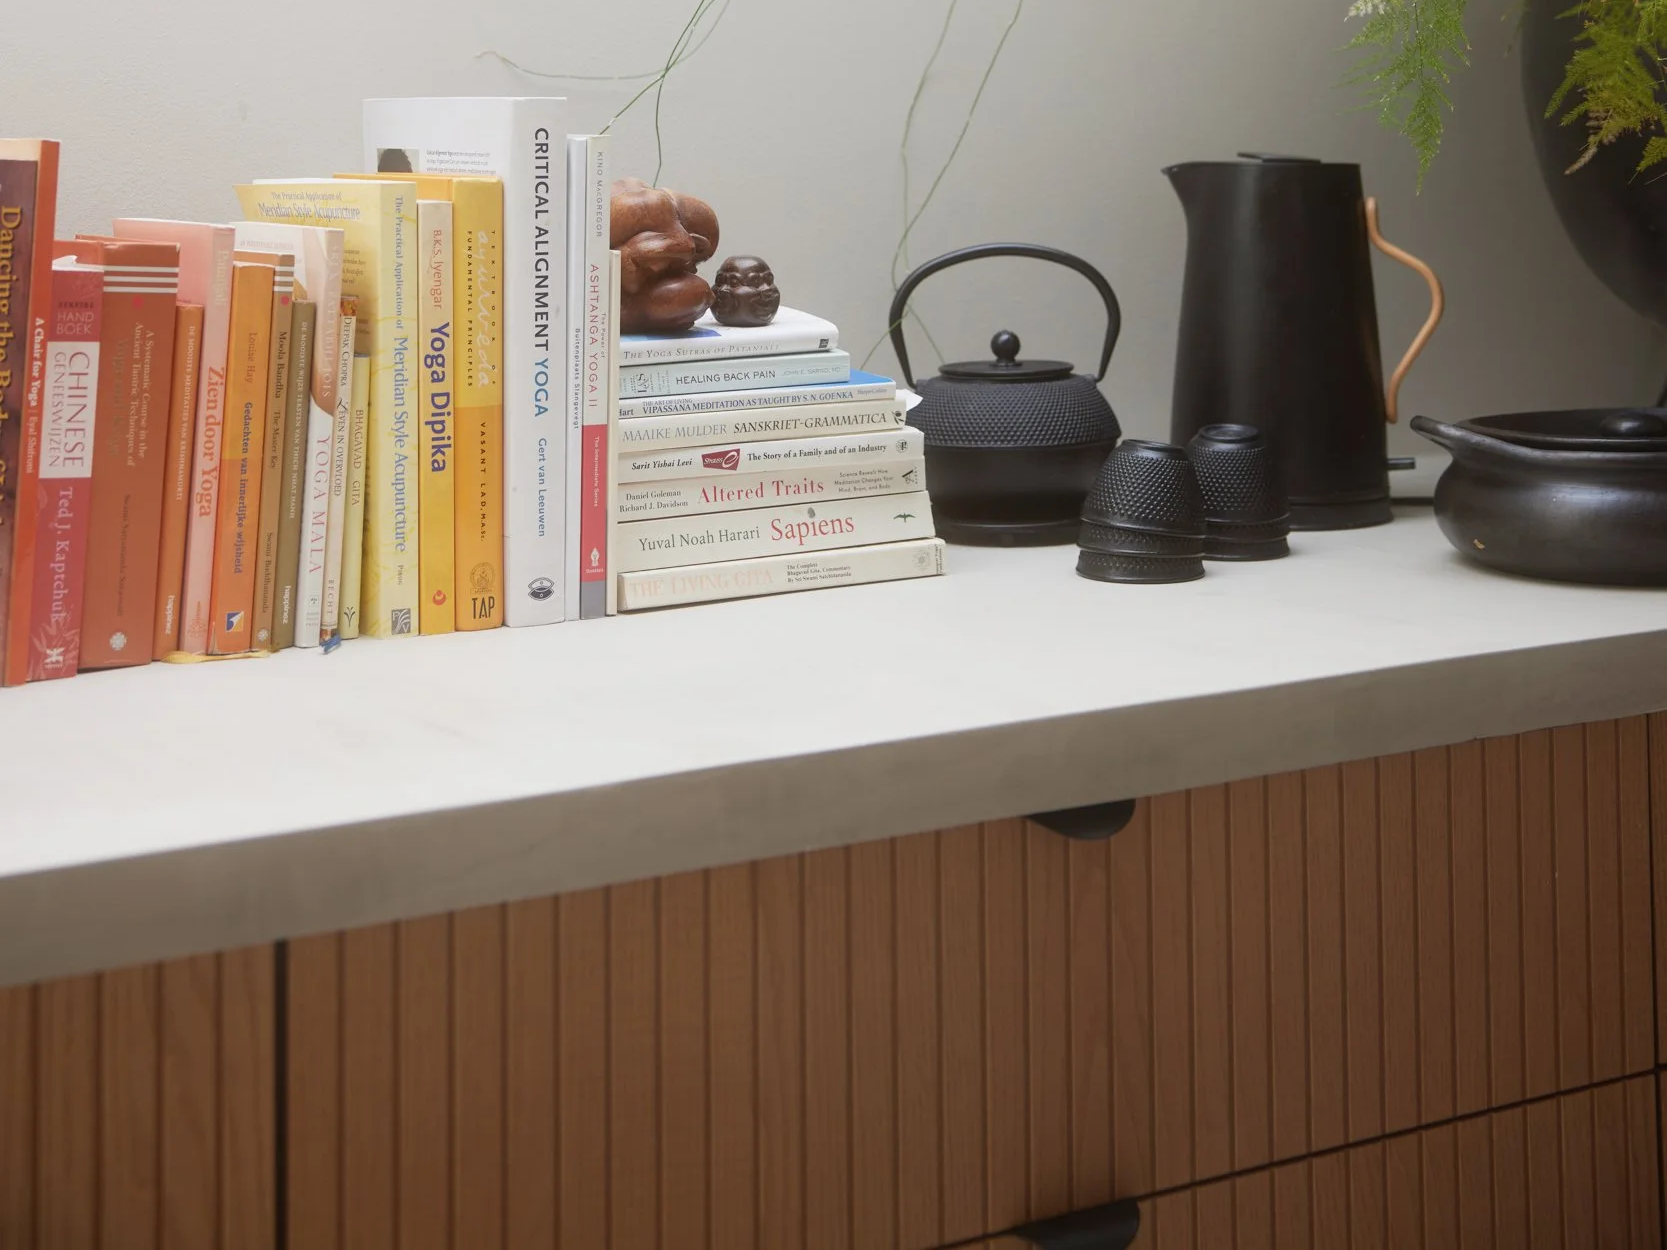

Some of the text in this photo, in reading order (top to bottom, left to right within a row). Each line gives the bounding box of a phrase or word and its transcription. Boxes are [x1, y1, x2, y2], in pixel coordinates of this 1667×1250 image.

[257, 203, 360, 221] Meridian Style Acupuncture
[305, 192, 334, 201] Application
[335, 192, 342, 200] of
[430, 229, 444, 310] B.K.S. Iyengar
[534, 127, 549, 417] CRITICAL ALIGNMENT YOGA
[35, 317, 45, 326] A
[57, 311, 95, 322] HAND
[463, 230, 492, 388] ayurveda
[32, 328, 45, 359] Chair
[56, 322, 92, 335] BOEK
[188, 326, 196, 335] DE
[300, 322, 308, 332] DE
[588, 263, 600, 407] ASHTANGA YOGA II
[245, 332, 258, 384] Louise Hay
[275, 331, 288, 399] Moola Bandha
[340, 317, 353, 386] DEEPAK CHOPRA
[623, 350, 643, 359] THE
[646, 349, 672, 358] YOGA
[676, 347, 711, 356] SUTRAS
[31, 360, 42, 377] for
[389, 196, 409, 553] The Practical Application of Meridian Style Acupuncture
[572, 328, 581, 430] Buitenplaats Slangevegt
[676, 370, 775, 385] HEALING BACK PAIN
[28, 380, 41, 407] Yoga
[47, 351, 67, 468] GENEESWIJZEN
[62, 351, 91, 468] CHINESE
[126, 322, 144, 467] Ancient Tantric Techniques of
[138, 330, 155, 459] A Systematic Course in the
[182, 374, 193, 420] MEDITATIES
[423, 322, 452, 472] Yoga Dipika
[642, 405, 692, 415] VIPASSANA
[693, 399, 746, 411] MEDITATION
[758, 395, 790, 406] TAUGHT
[791, 395, 801, 404] BY
[819, 391, 853, 401] GOENKA
[295, 394, 303, 427] TEKSTEN
[180, 422, 188, 439] VAN
[195, 366, 225, 518] Zien door Yoga
[293, 429, 301, 444] VAN
[623, 413, 887, 442] MAAIKE MULDER SANSKRIET-GRAMMATICA
[292, 446, 300, 471] THICH
[333, 397, 349, 496] LEVEN IN OVERVLOED
[351, 409, 364, 506] BHAGAVAD GITA
[747, 453, 761, 461] The
[763, 451, 781, 460] Story
[783, 450, 792, 458] of
[799, 448, 822, 458] Family
[824, 447, 837, 455] and
[838, 446, 847, 454] of
[858, 443, 887, 453] Industry
[631, 458, 692, 470] Sarit Yishai Levi
[234, 402, 254, 574] Gedachten van innerlijke wijsheid
[538, 437, 547, 537] Gert van Leeuwen
[626, 490, 681, 501] Daniel Goleman
[697, 478, 825, 504] Altered Traits
[288, 496, 296, 519] HANH
[308, 434, 331, 575] YOGA MALA
[619, 503, 647, 513] Richard
[657, 500, 689, 510] Davidson
[638, 516, 855, 551] Yuval Noah Harari Sapiens
[50, 487, 73, 622] Ted J. Kaptchuk
[629, 567, 773, 597] THE LIVING GITA
[165, 595, 175, 634] happinez
[283, 584, 292, 625] happinez
[471, 595, 495, 620] TAP
